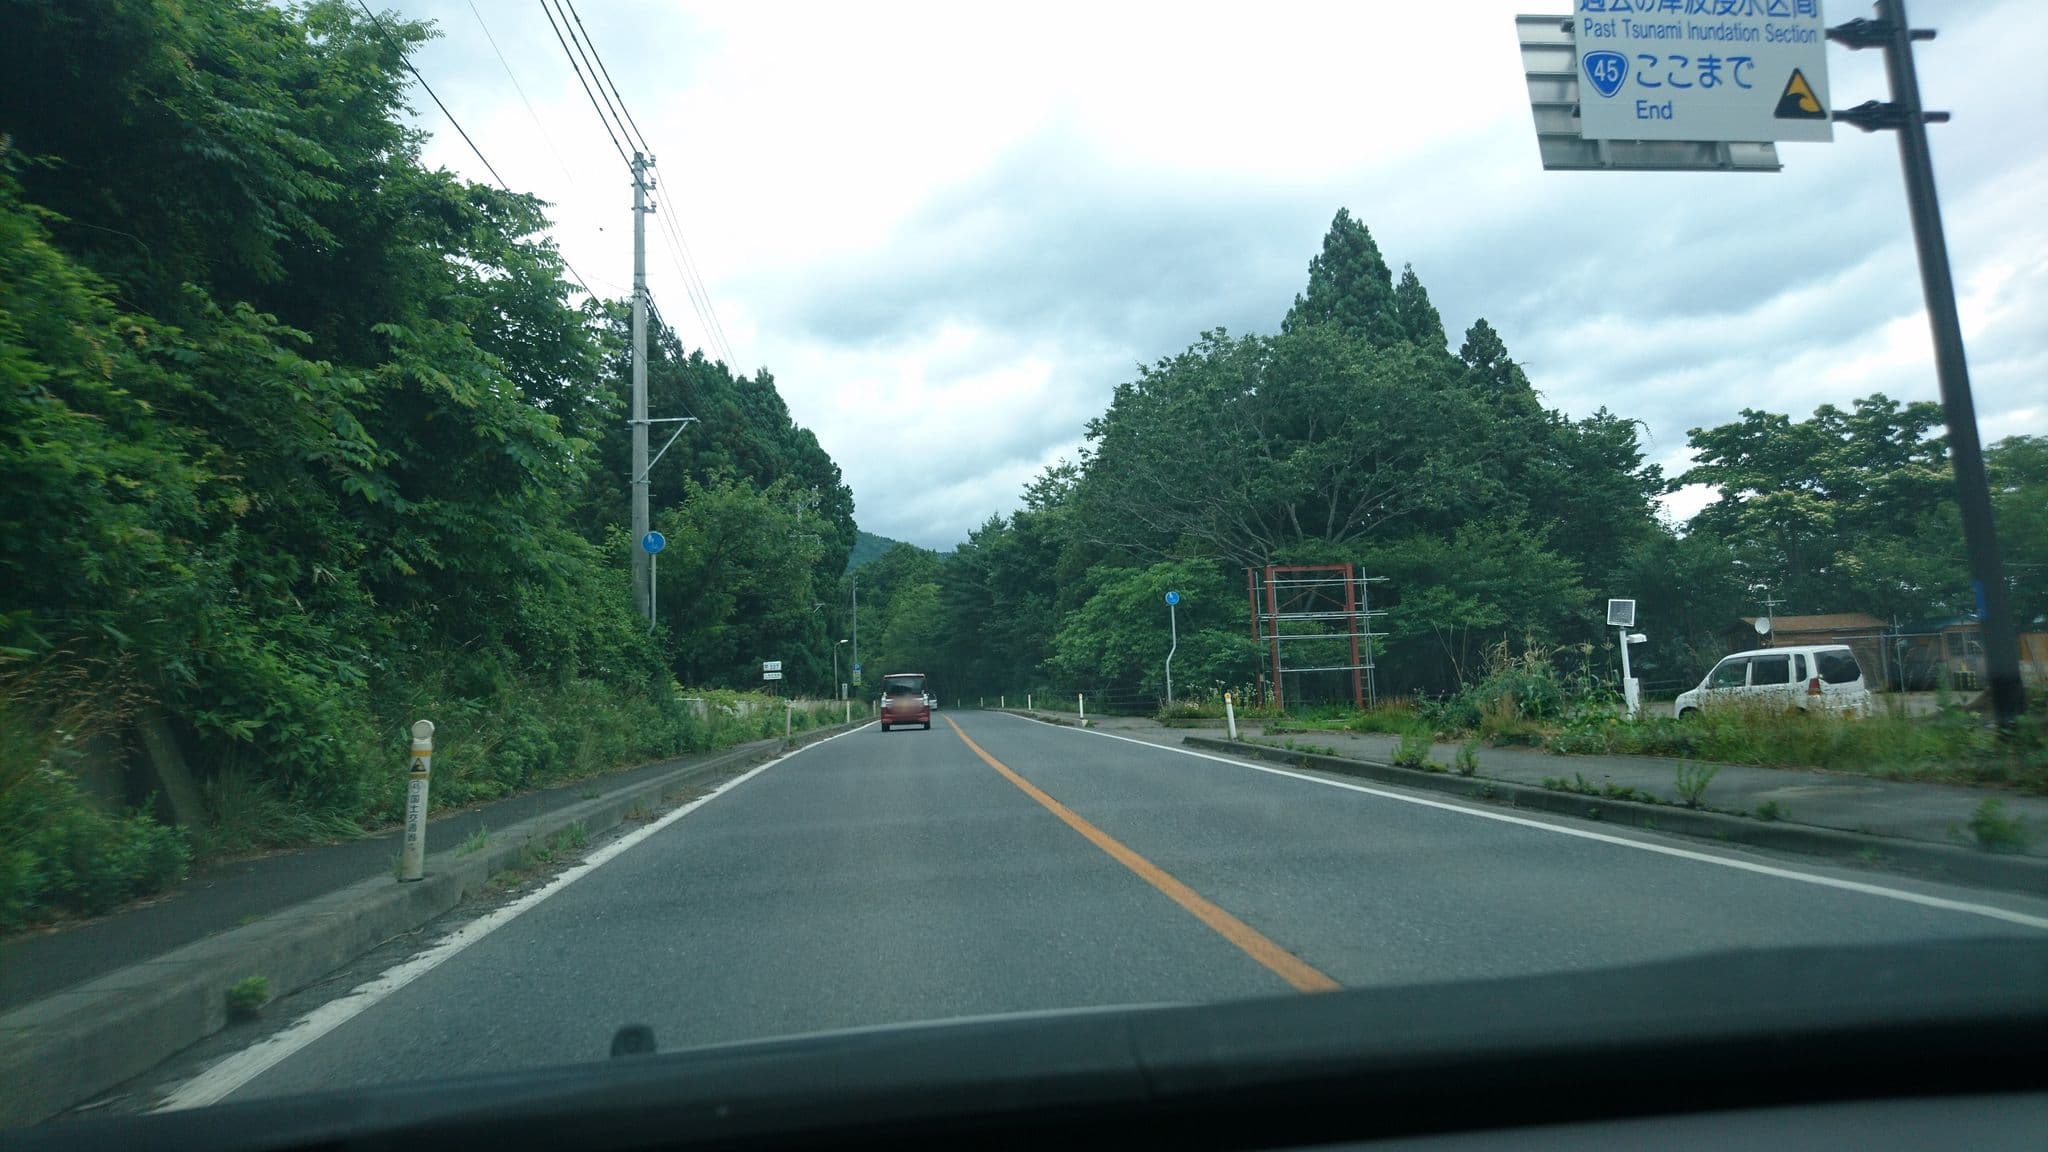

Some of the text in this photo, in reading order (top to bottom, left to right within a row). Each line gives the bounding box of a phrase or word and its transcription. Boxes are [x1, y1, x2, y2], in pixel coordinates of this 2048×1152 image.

[1584, 18, 1817, 44] Past Tsunami Inundation Section
[1594, 59, 1619, 82] 45
[1636, 54, 1755, 89] ここまで
[1636, 100, 1673, 120] End
